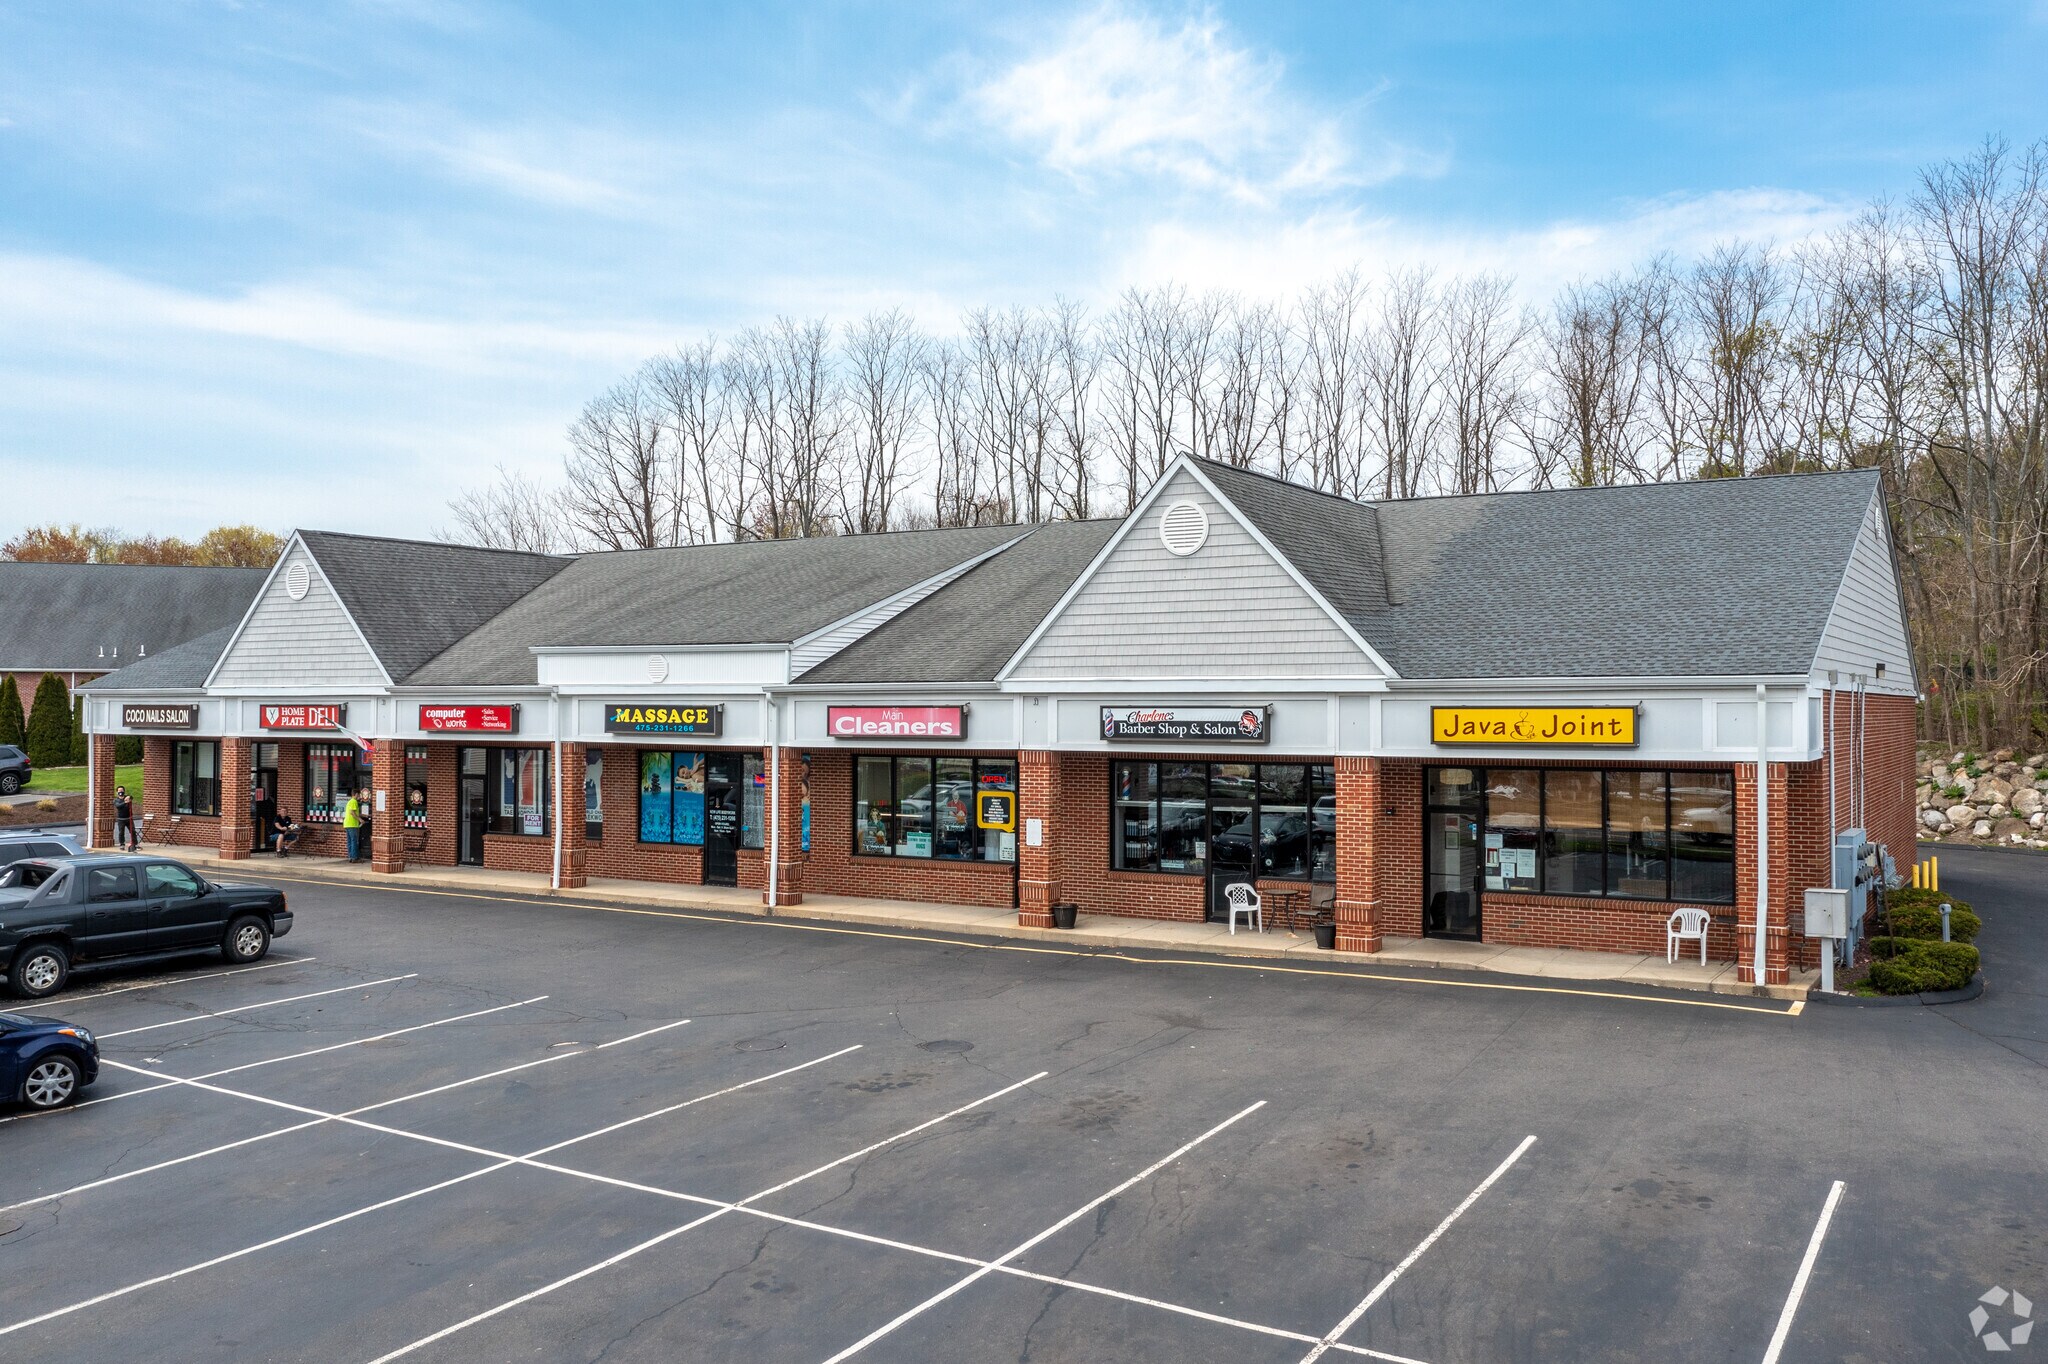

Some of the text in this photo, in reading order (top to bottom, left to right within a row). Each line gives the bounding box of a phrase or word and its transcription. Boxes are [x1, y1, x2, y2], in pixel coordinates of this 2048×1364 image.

[125, 709, 189, 723] COCO NAILS SALON
[281, 707, 304, 716] HOME
[308, 707, 335, 726] DELI
[425, 708, 465, 719] computer
[615, 708, 708, 724] MASSAGE
[881, 710, 903, 720] Main
[1127, 709, 1174, 723] Charlenes
[281, 717, 304, 726] PLATE
[445, 719, 466, 728] works
[483, 721, 506, 729] Networking
[836, 716, 952, 734] Cleaners
[1443, 714, 1622, 737] Java Joint
[635, 724, 694, 732] 475-231-1266
[1119, 722, 1237, 737] Barber Shop & Salon
[981, 775, 1006, 783] OPEN
